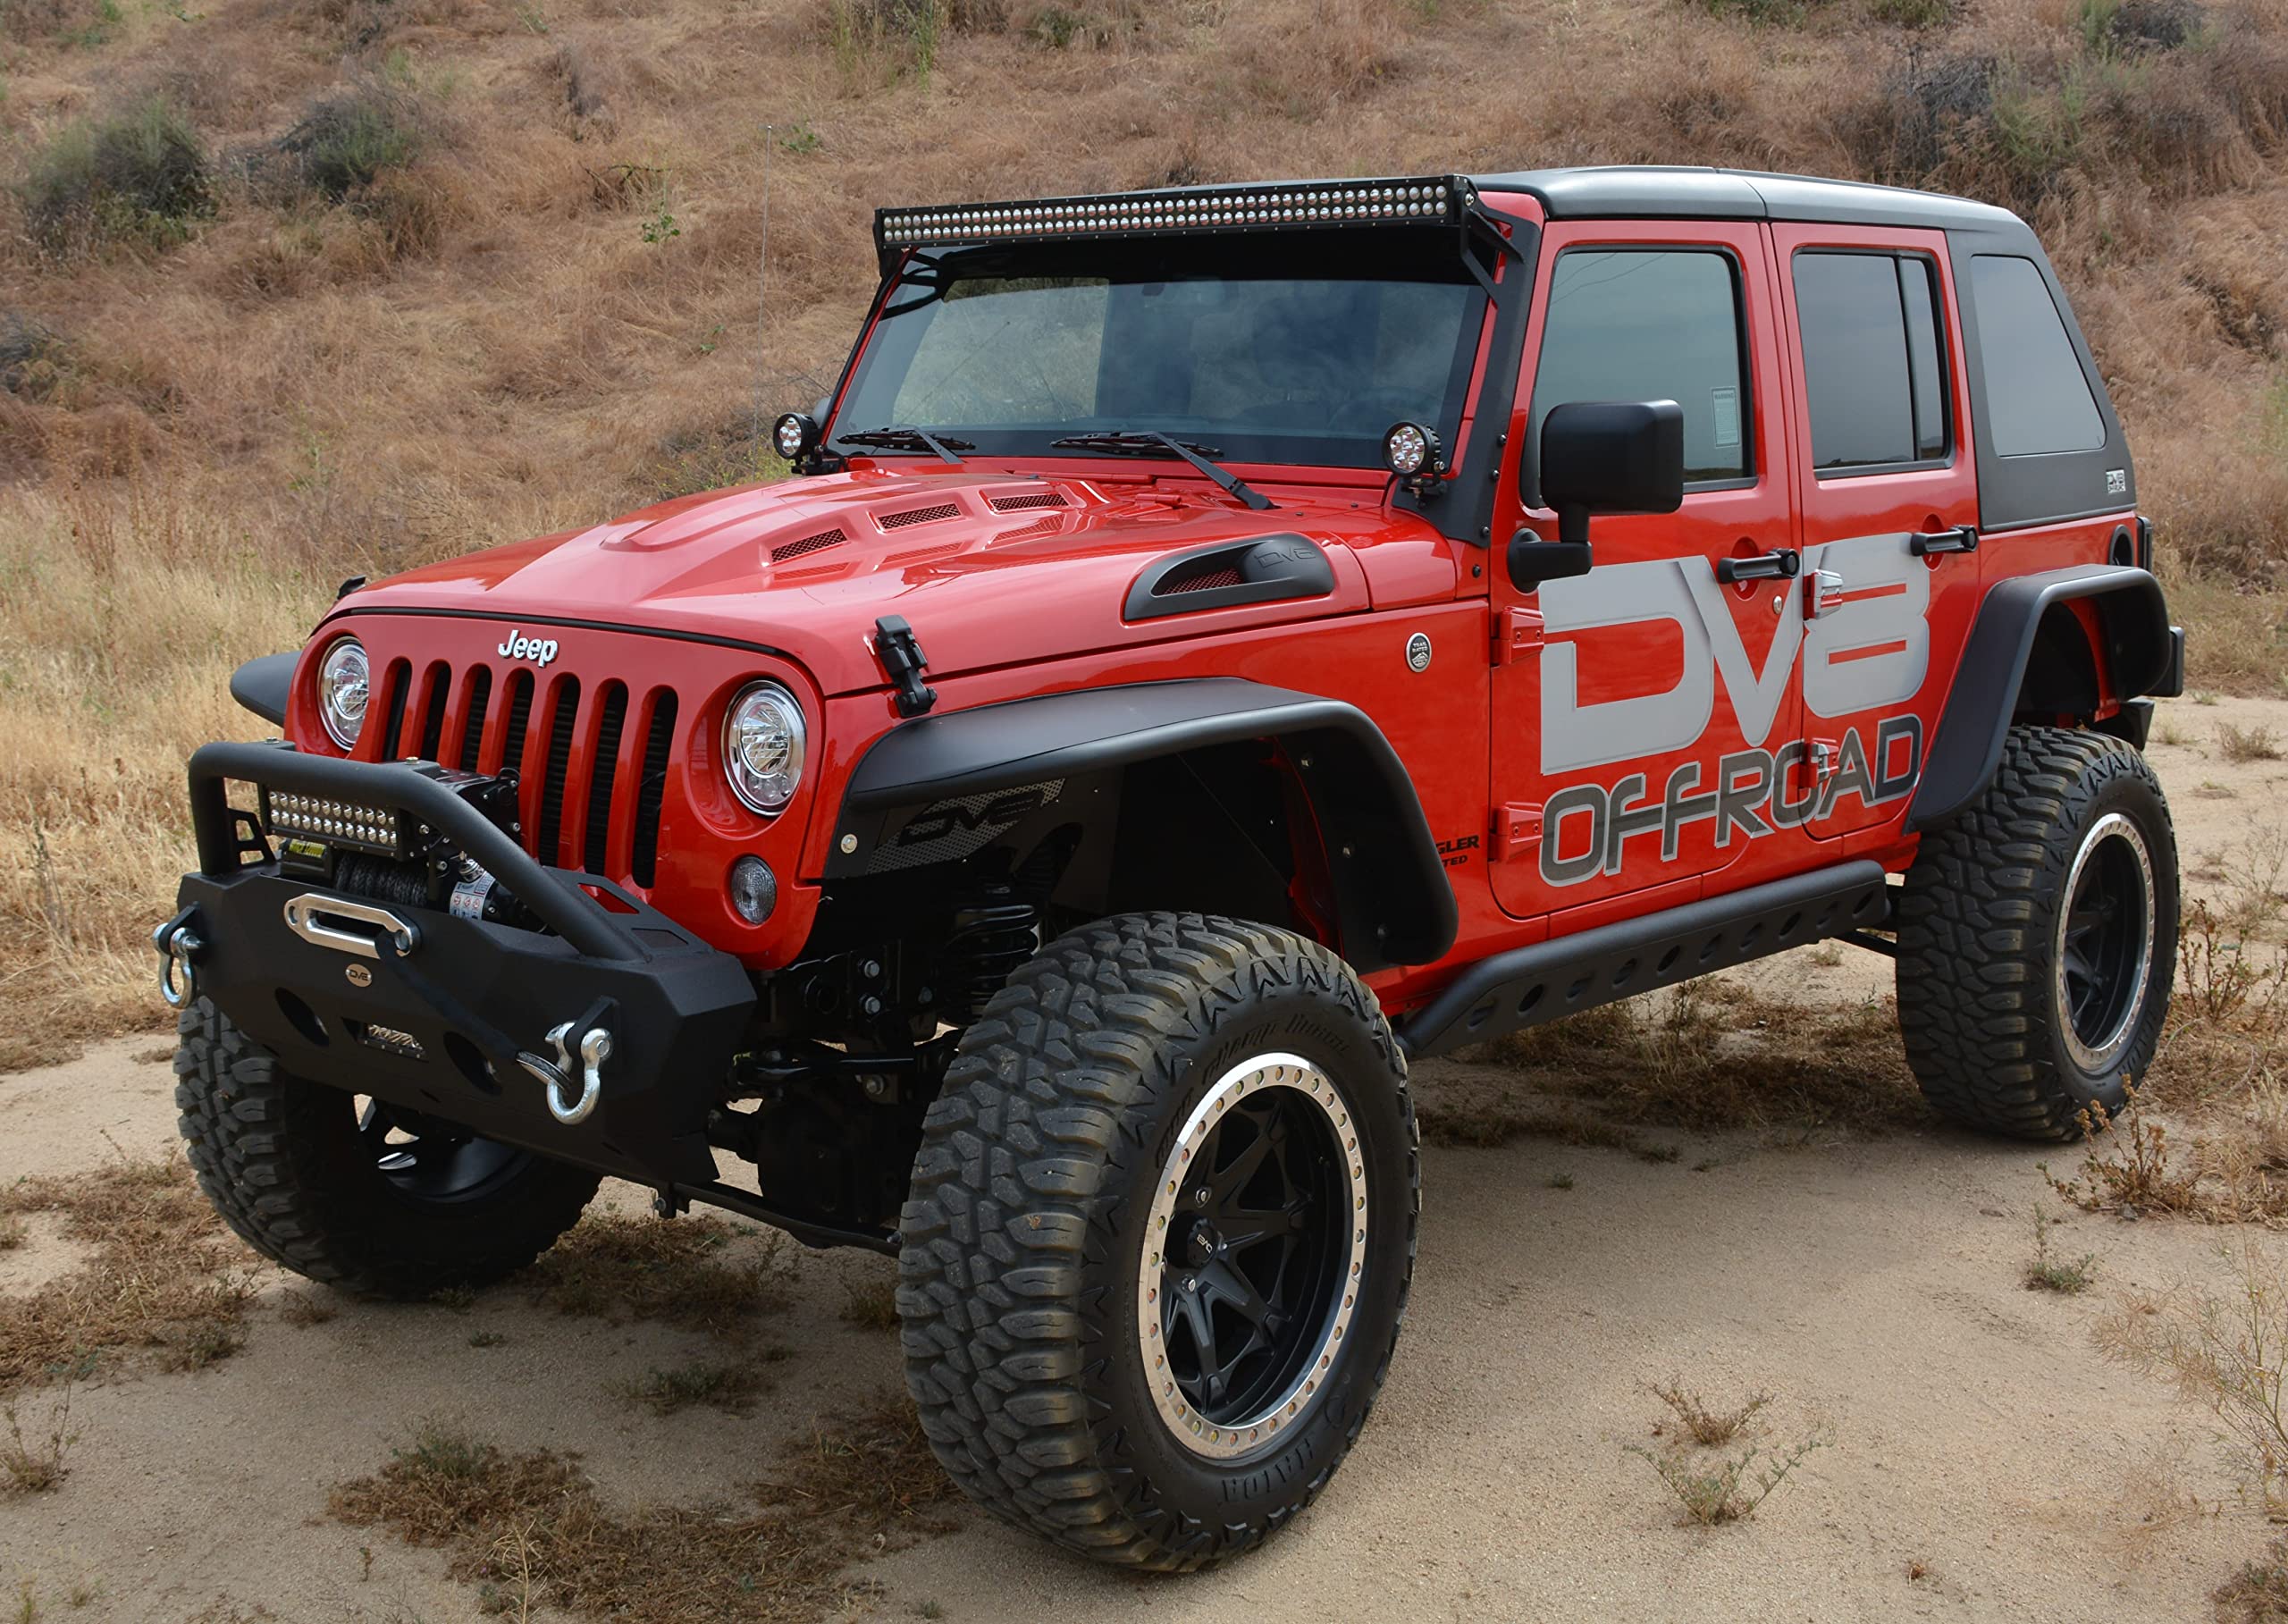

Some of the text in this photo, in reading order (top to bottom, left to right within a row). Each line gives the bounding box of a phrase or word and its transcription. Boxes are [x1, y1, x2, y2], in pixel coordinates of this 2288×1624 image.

[1253, 546, 1317, 568] DV8
[498, 628, 559, 669] Jeep
[1538, 532, 1930, 777] DV8
